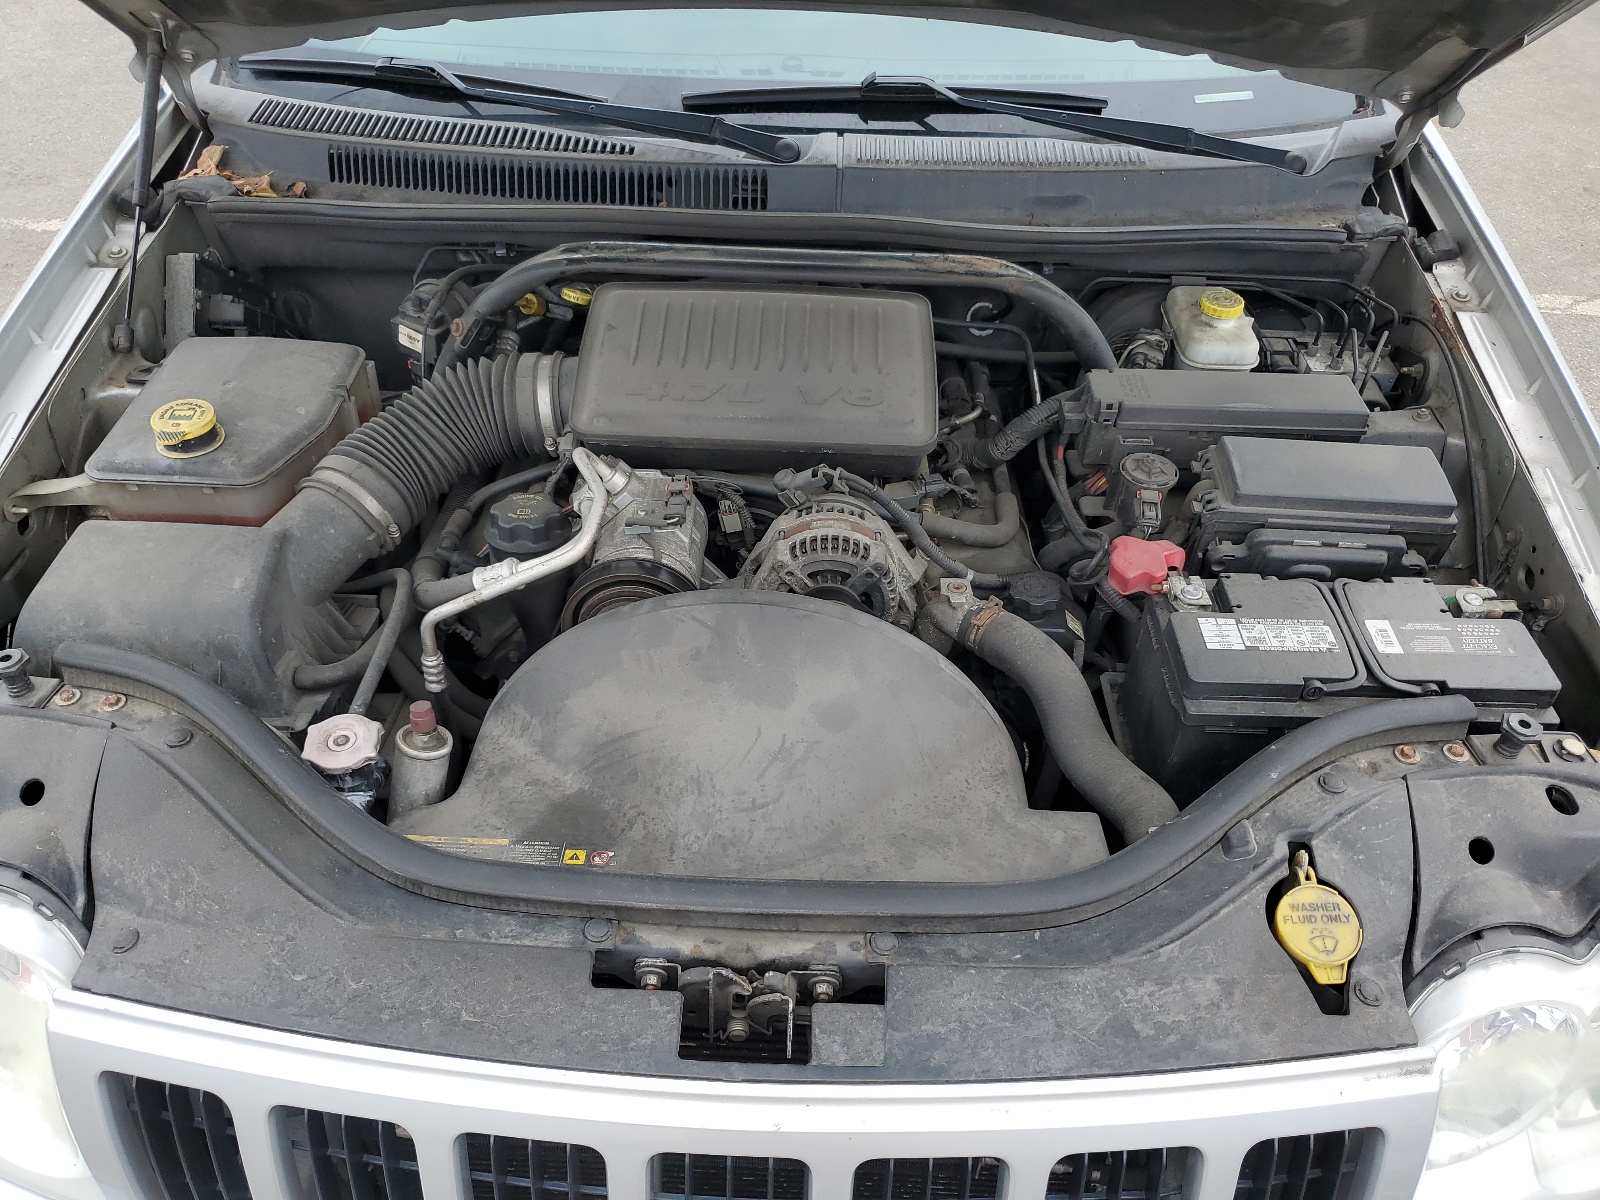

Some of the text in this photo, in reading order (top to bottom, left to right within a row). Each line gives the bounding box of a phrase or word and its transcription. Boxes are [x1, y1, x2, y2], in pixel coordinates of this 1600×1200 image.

[796, 384, 885, 408] V8
[1289, 902, 1341, 912] WASHER
[1283, 913, 1351, 925] FLUID ONLY
